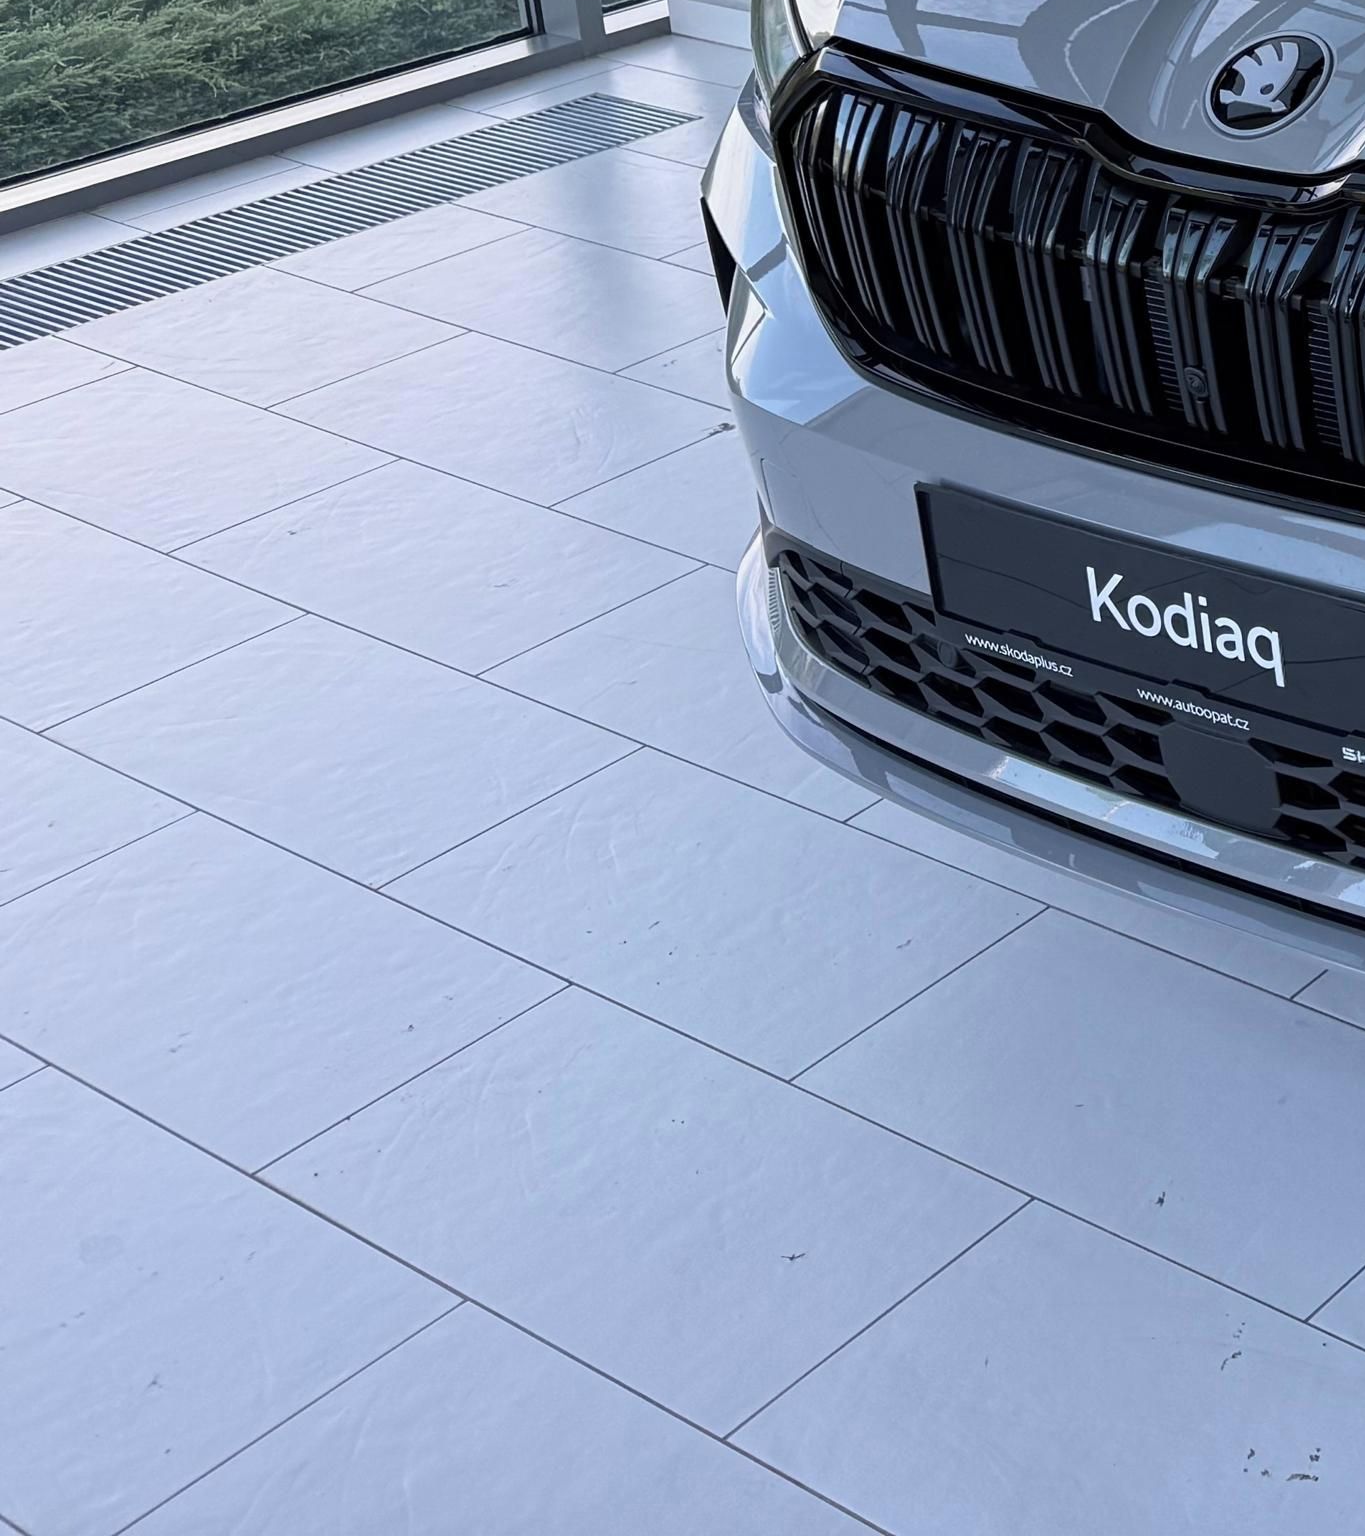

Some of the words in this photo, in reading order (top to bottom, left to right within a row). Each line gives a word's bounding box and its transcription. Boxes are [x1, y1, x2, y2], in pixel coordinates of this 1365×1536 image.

[1086, 566, 1285, 687] Kodiaq
[964, 633, 1074, 677] www.skodaplus.cz
[1136, 688, 1250, 731] www.autoopat.cz
